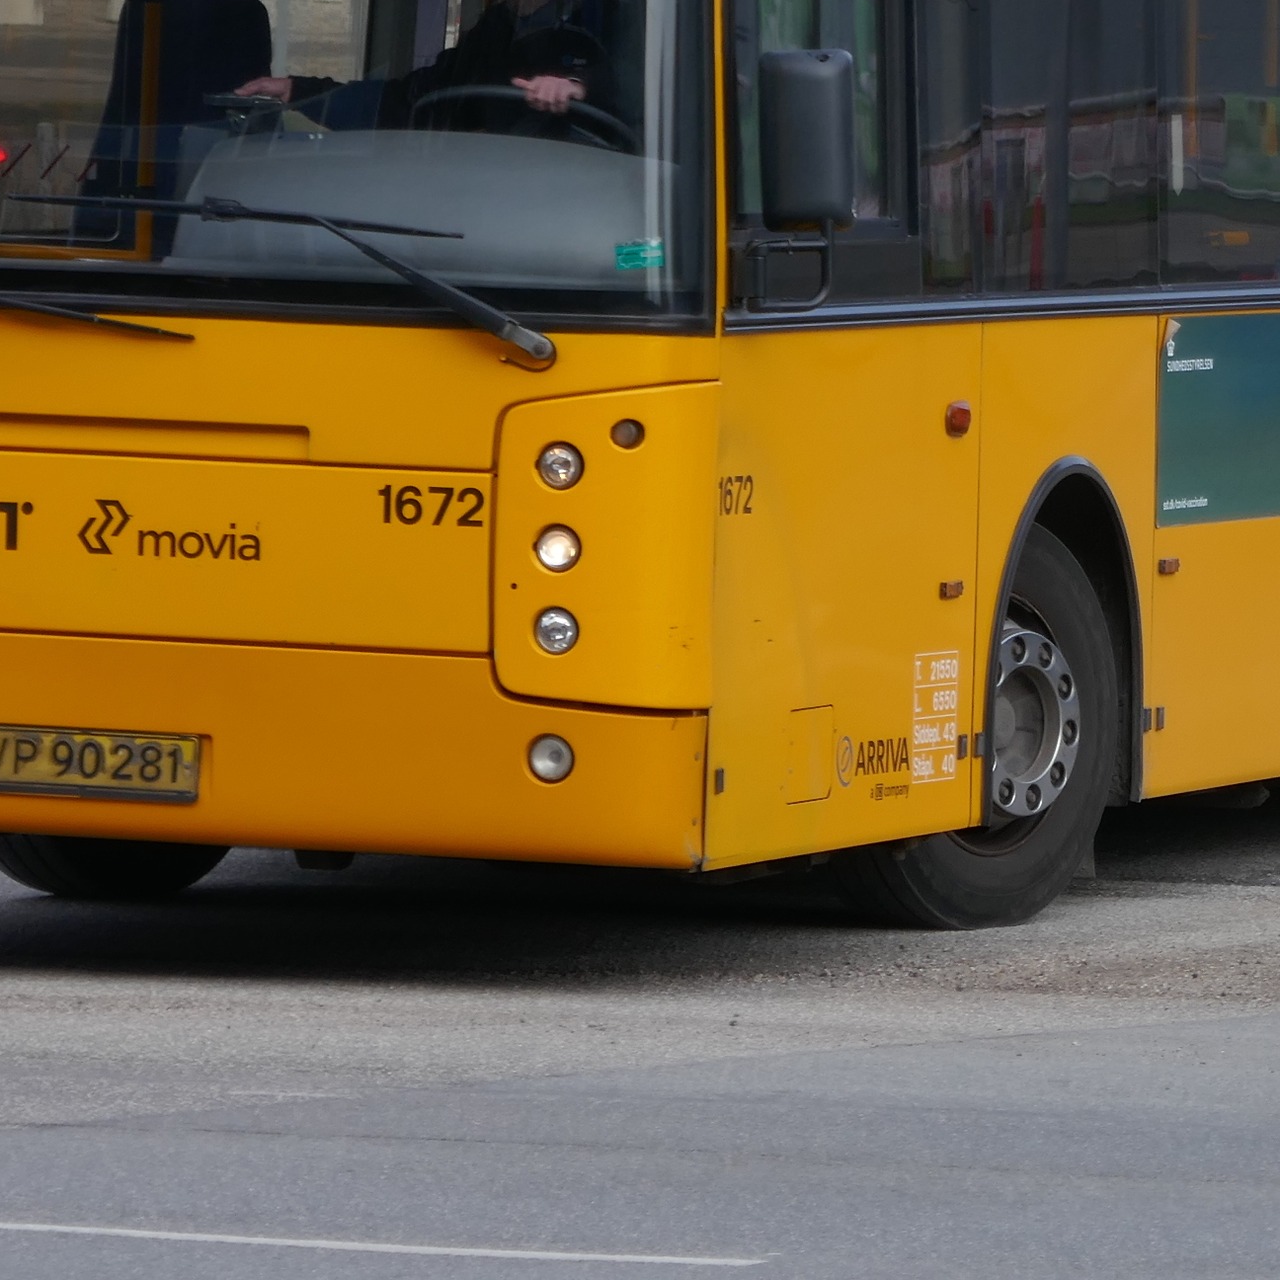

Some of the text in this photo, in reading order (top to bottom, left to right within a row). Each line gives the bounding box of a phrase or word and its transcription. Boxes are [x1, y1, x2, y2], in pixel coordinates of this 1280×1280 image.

[377, 484, 484, 528] 1672
[719, 475, 754, 516] 1672
[137, 523, 262, 562] movia
[930, 658, 958, 681] 21550
[933, 689, 957, 712] 6550
[52, 740, 185, 784] 90281
[854, 736, 910, 777] ARRIVA
[942, 754, 955, 774] 40
